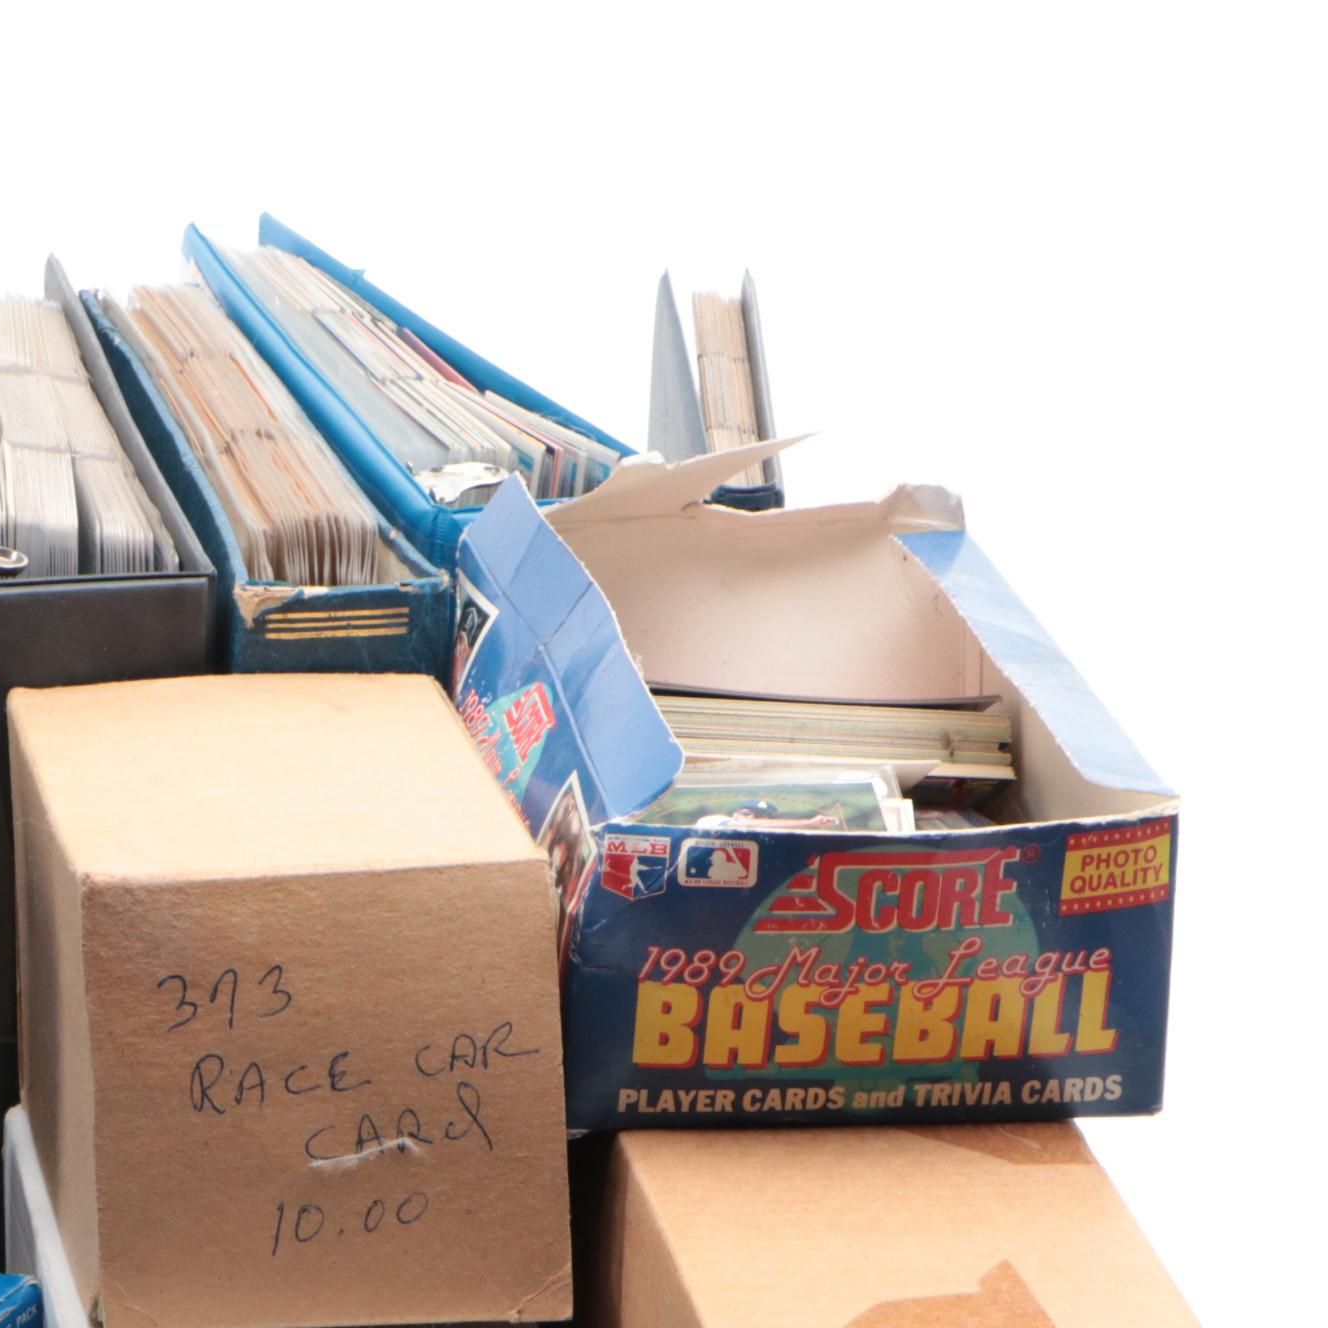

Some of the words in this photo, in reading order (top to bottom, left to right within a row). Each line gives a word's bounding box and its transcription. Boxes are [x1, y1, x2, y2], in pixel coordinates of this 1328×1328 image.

[608, 841, 668, 855] MLB
[1069, 862, 1166, 895] QUALITY
[1079, 846, 1157, 873] PHOTO
[753, 848, 1021, 935] SCORE
[157, 964, 293, 1033] 373
[638, 946, 745, 986] 1989
[745, 946, 908, 1007] Major
[918, 937, 1111, 998] League
[632, 969, 1118, 1069] BASEBALL
[189, 1050, 372, 1115] RACE
[414, 1021, 541, 1078] CAR
[618, 1087, 733, 1113] PLAYER
[746, 1086, 846, 1110] CARDS
[850, 1084, 904, 1109] and
[913, 1082, 1013, 1108] TRIVIA
[1020, 1075, 1123, 1102] CARDS
[272, 1191, 430, 1258] 10.00
[16, 1303, 39, 1328] PACK
